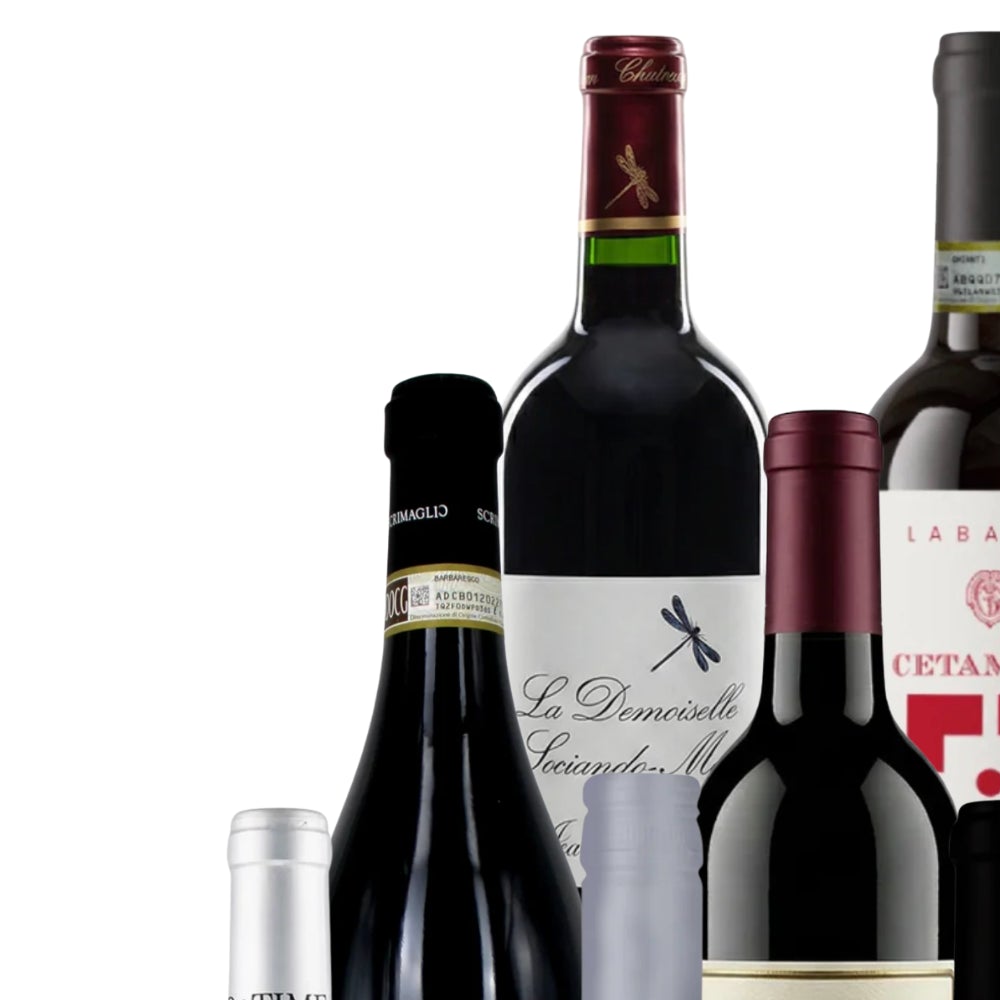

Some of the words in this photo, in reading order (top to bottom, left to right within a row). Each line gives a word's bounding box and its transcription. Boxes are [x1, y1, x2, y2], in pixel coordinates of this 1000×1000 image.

[434, 574, 480, 583] BARBARESCO
[516, 674, 569, 720] La
[572, 676, 744, 722] Demoiselle
